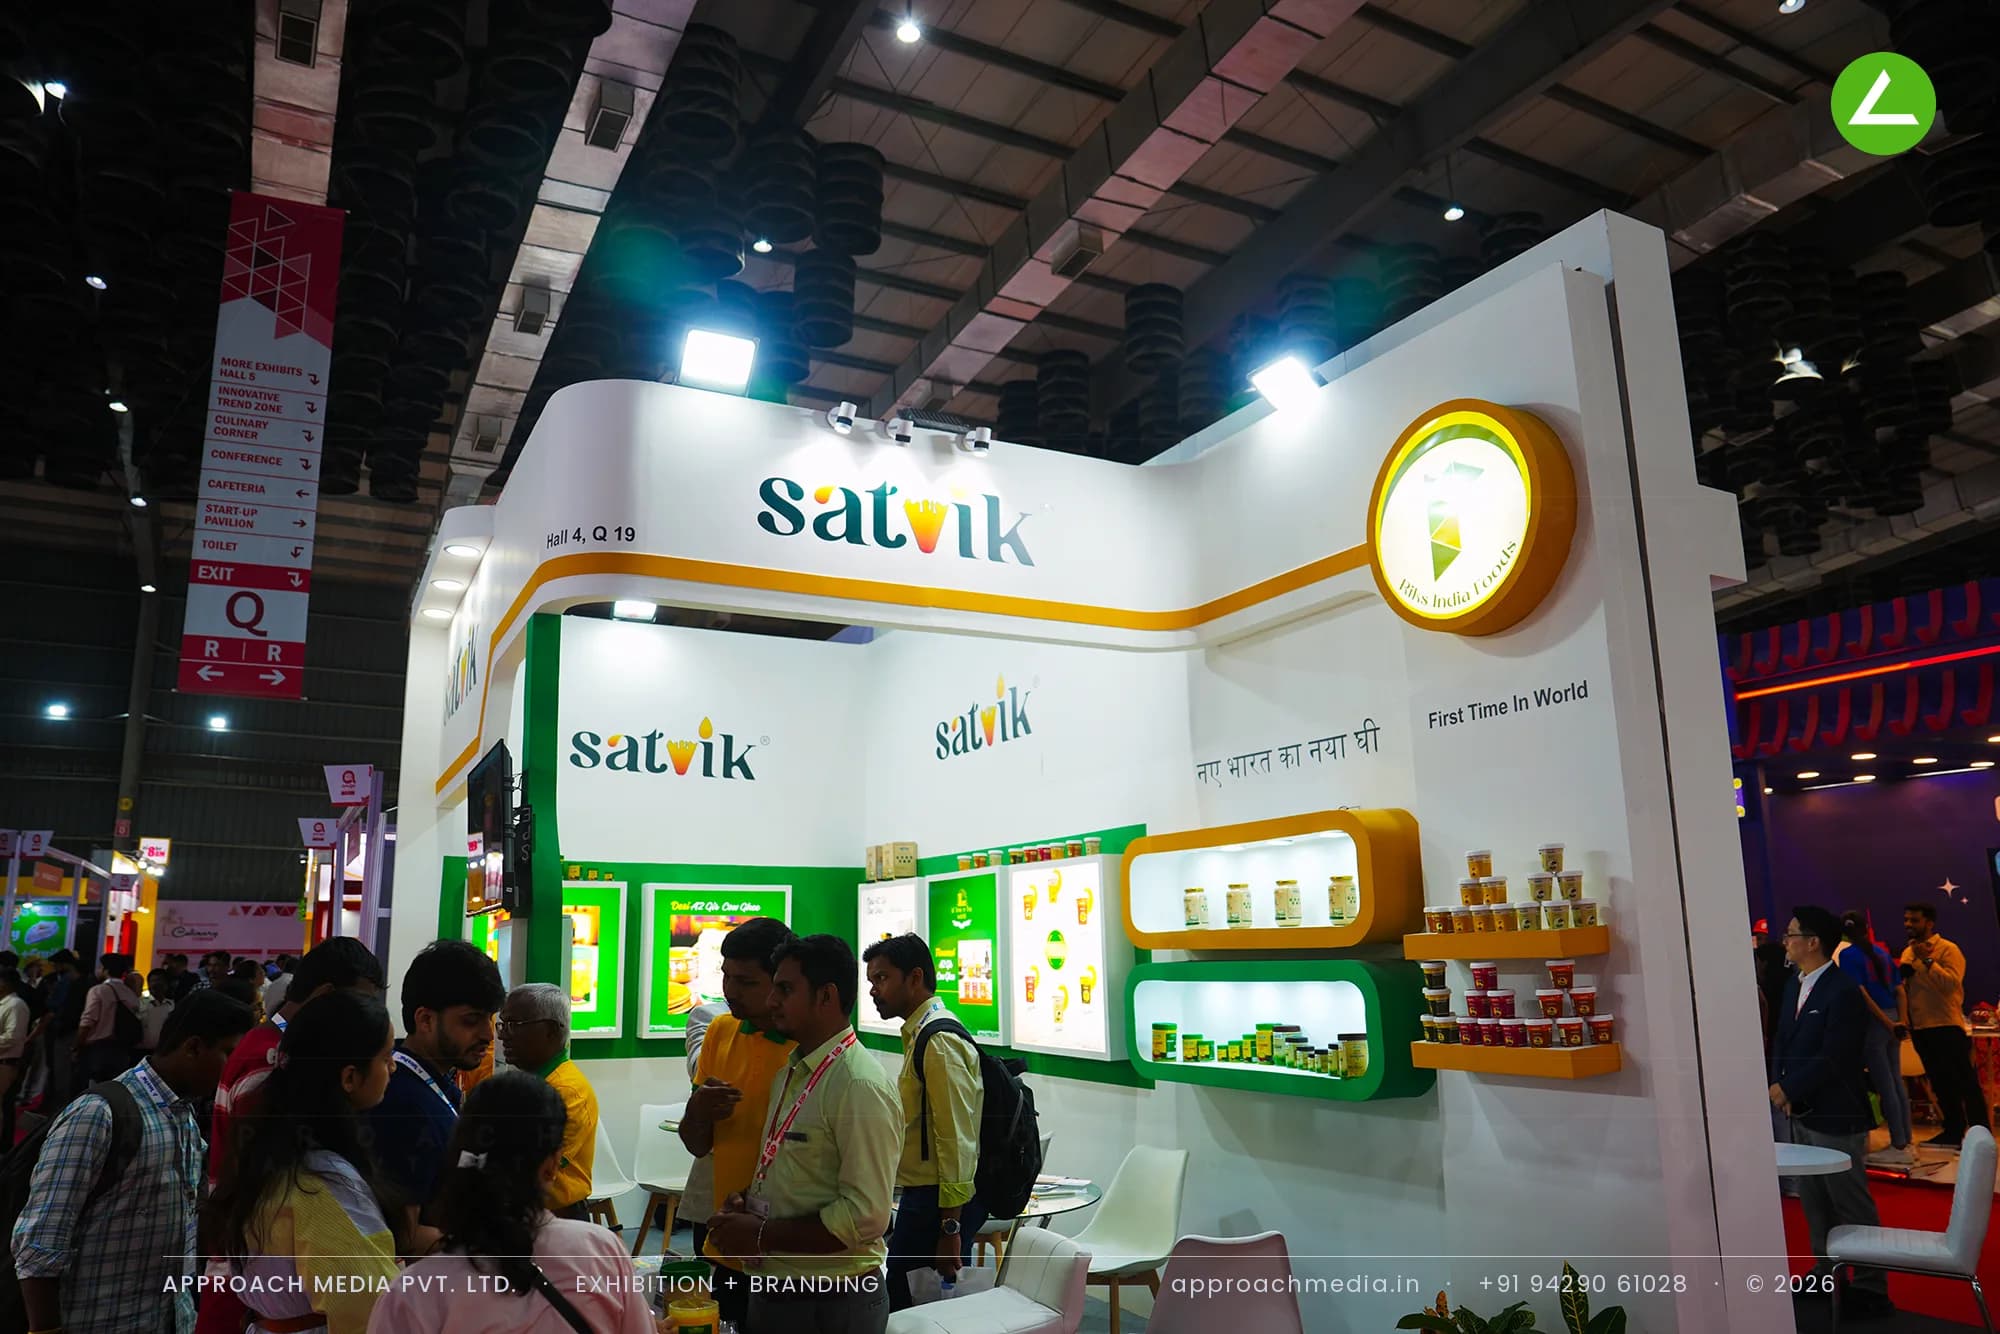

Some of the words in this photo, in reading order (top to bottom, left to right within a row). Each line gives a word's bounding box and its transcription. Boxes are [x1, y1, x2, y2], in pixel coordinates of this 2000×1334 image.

[220, 368, 246, 380] HALL
[248, 372, 256, 382] 5
[221, 357, 253, 369] MORE
[255, 362, 303, 377] EXHIBITS
[218, 386, 280, 402] INNOVATIVE
[217, 397, 251, 411] TREND
[254, 401, 283, 414] ZONE
[215, 415, 269, 430] CULINARY
[213, 426, 258, 440] CORNER
[211, 449, 282, 466] CONFERENCE
[207, 479, 266, 494] CAFETERIA
[205, 504, 258, 517] START-UP
[204, 515, 254, 529] PAVILION
[757, 477, 1035, 567] satvik
[202, 539, 238, 552] TOILET
[547, 529, 568, 549] Hall
[572, 527, 586, 545] 4,
[592, 525, 607, 542] Q
[614, 526, 636, 542] 19
[197, 565, 235, 581] EXIT
[226, 591, 268, 637] Q
[204, 640, 220, 657] R
[267, 645, 282, 662] R
[1428, 707, 1464, 729] First
[1467, 701, 1508, 721] Time
[1513, 695, 1529, 712] In
[1533, 680, 1589, 707] World
[936, 672, 1032, 760] satvik
[569, 716, 757, 781] satvik
[1196, 760, 1222, 788] नए
[1227, 750, 1273, 778] भारत
[1278, 743, 1302, 769] का
[1308, 734, 1347, 763] नया
[1354, 718, 1381, 754] घी
